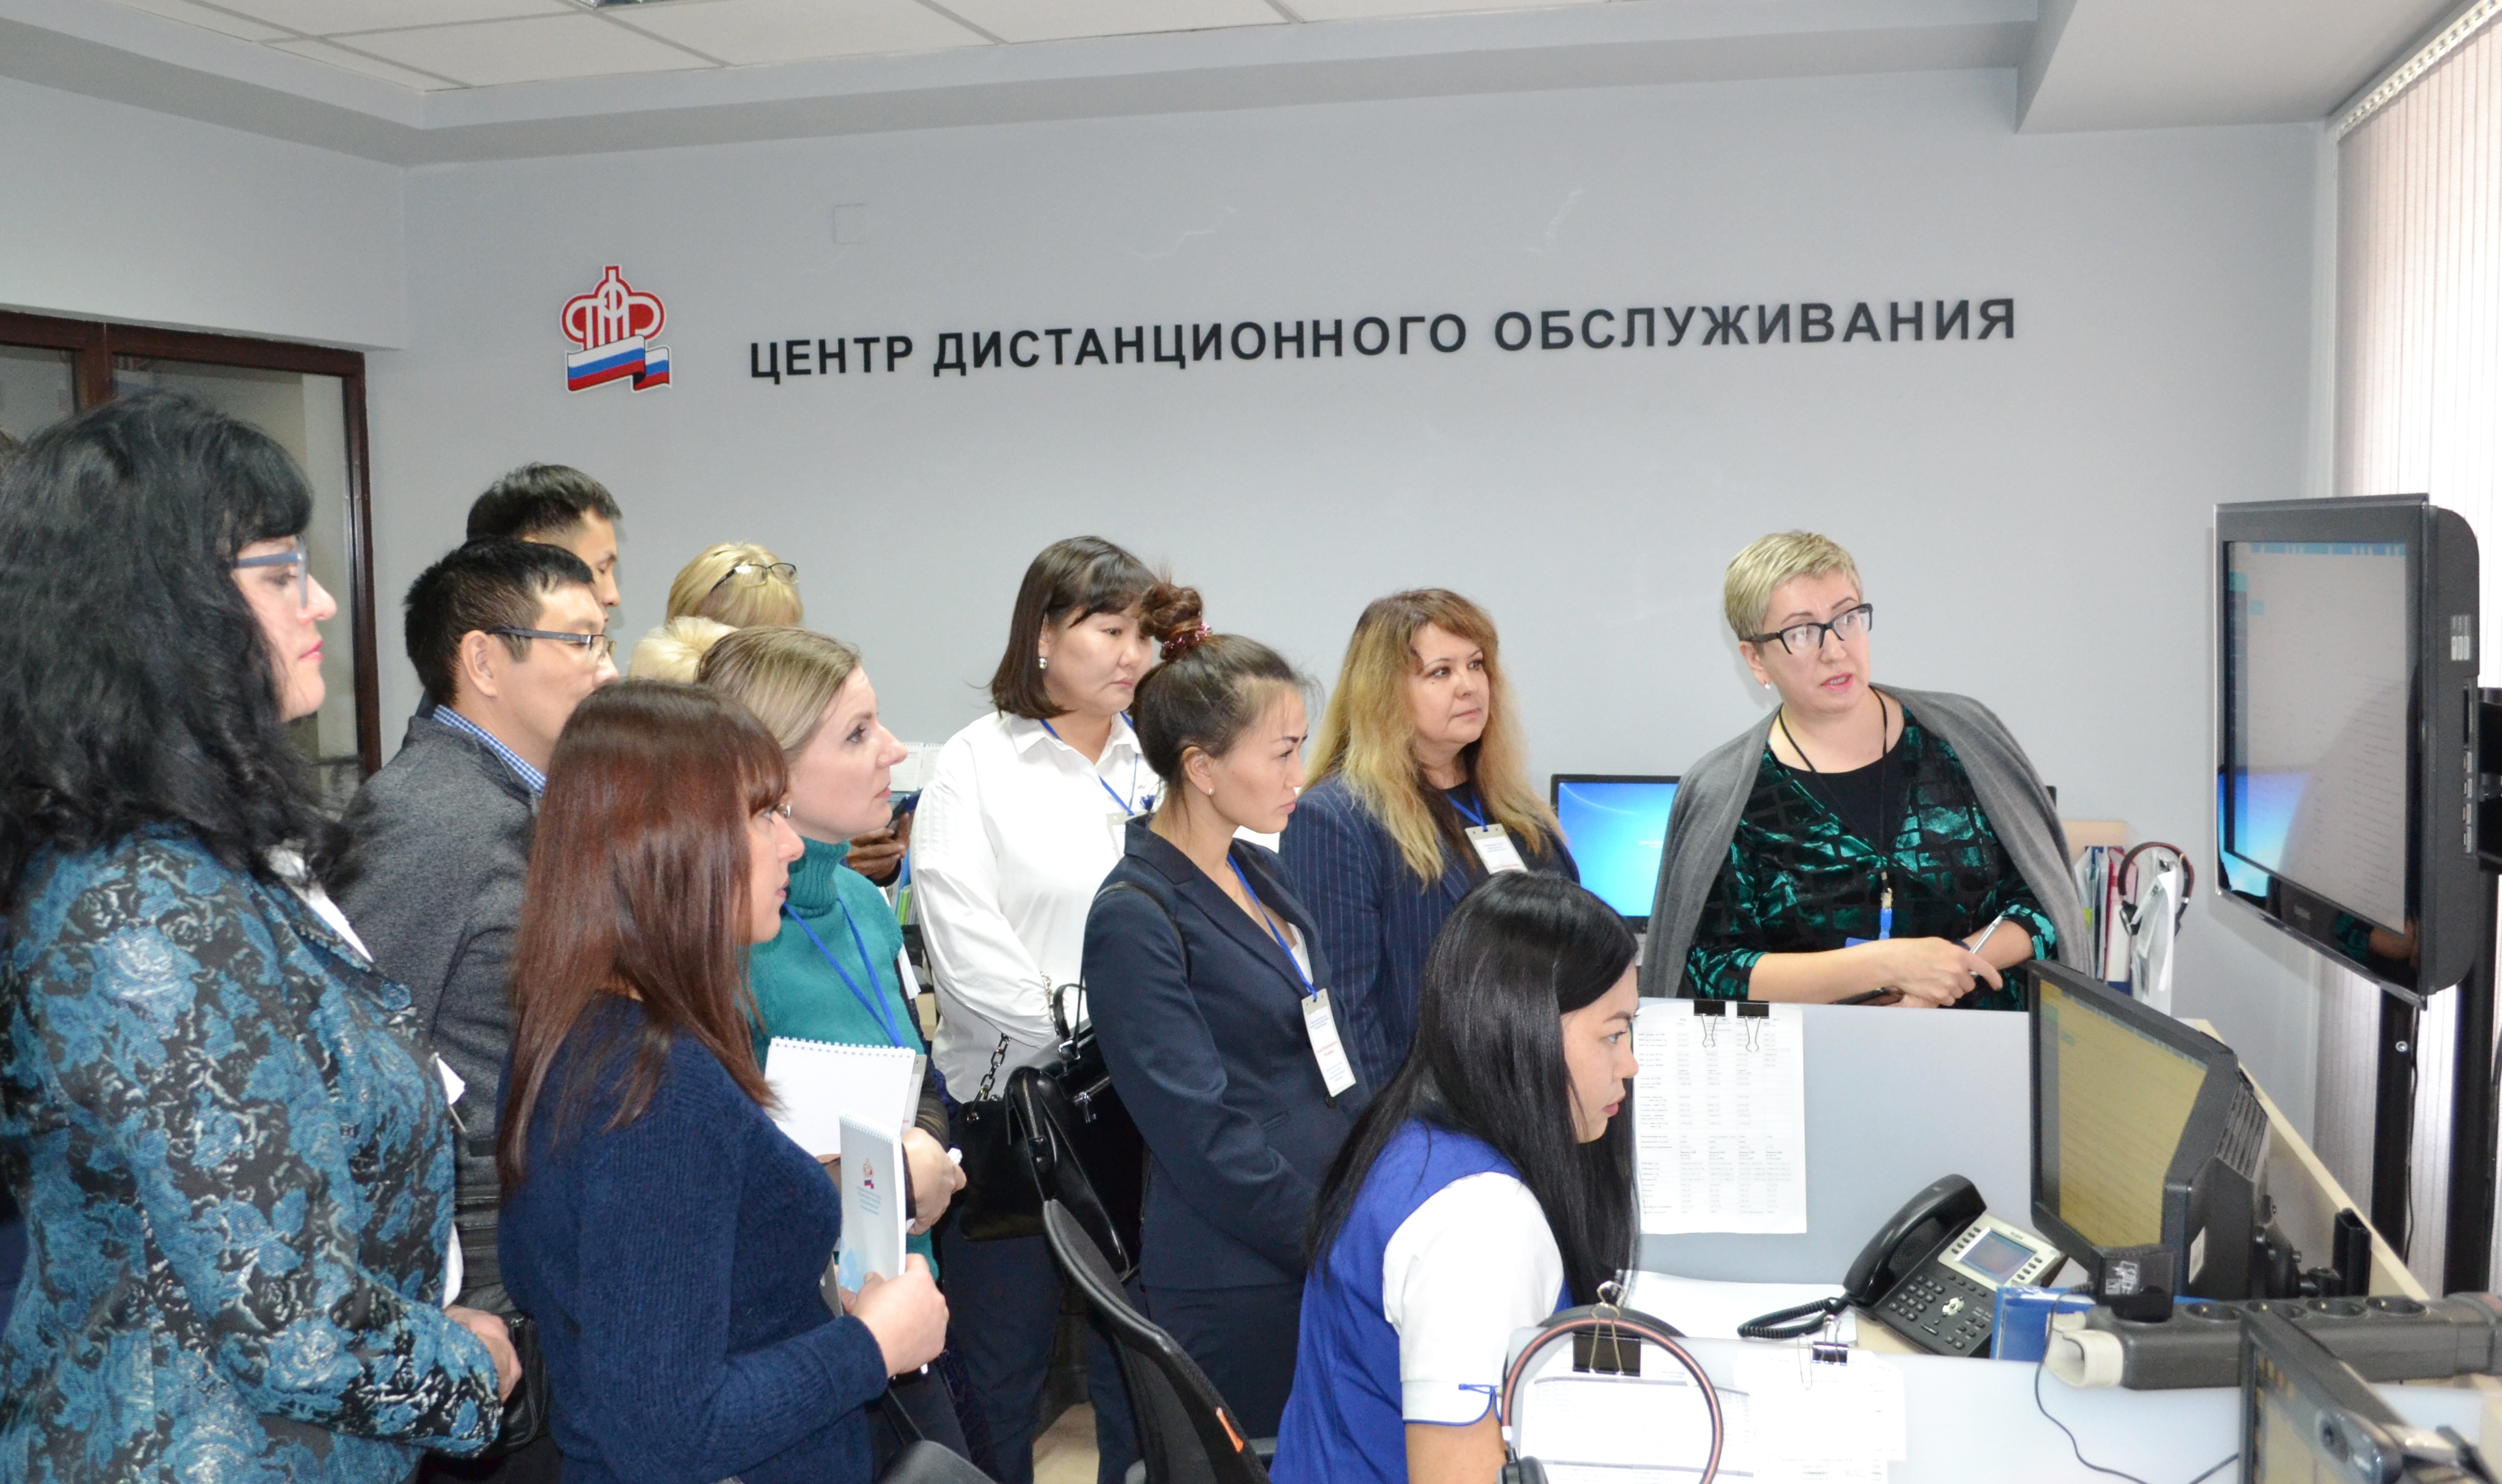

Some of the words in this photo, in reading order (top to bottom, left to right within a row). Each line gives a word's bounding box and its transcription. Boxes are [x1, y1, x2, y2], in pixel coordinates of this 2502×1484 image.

[750, 335, 913, 385] ЦЕНТР
[933, 313, 1466, 377] ДИСТАНЦИОННОГО
[1494, 298, 2014, 351] ОБСЛУЖИВАНИЯ
